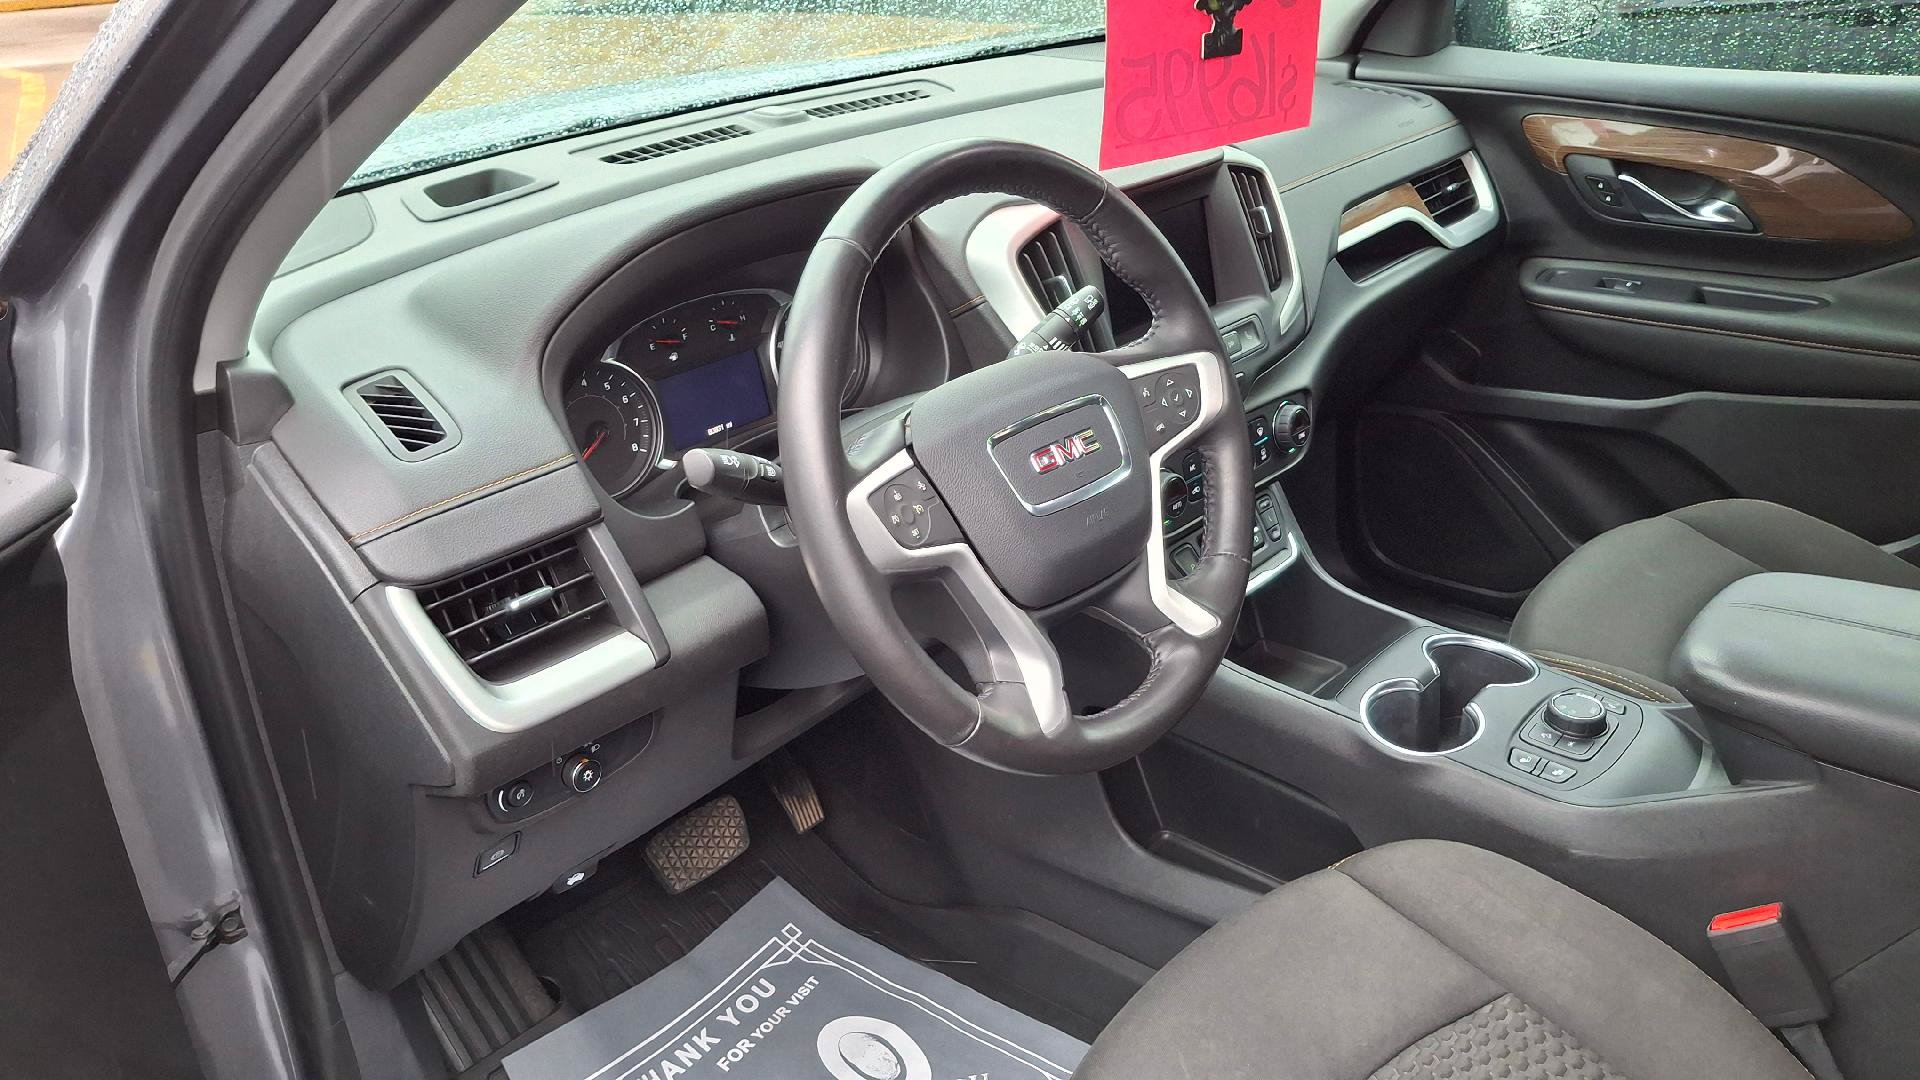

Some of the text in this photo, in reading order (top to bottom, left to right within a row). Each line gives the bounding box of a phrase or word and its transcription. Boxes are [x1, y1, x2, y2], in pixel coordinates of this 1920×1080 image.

[649, 342, 656, 351] E
[581, 378, 588, 387] 4
[603, 381, 611, 391] 5
[622, 395, 629, 404] 6
[633, 417, 639, 427] 7
[631, 442, 639, 452] 8
[1030, 427, 1101, 476] GMC
[716, 977, 776, 1026] YOU
[716, 975, 820, 1072] FOR YOUR VISIT
